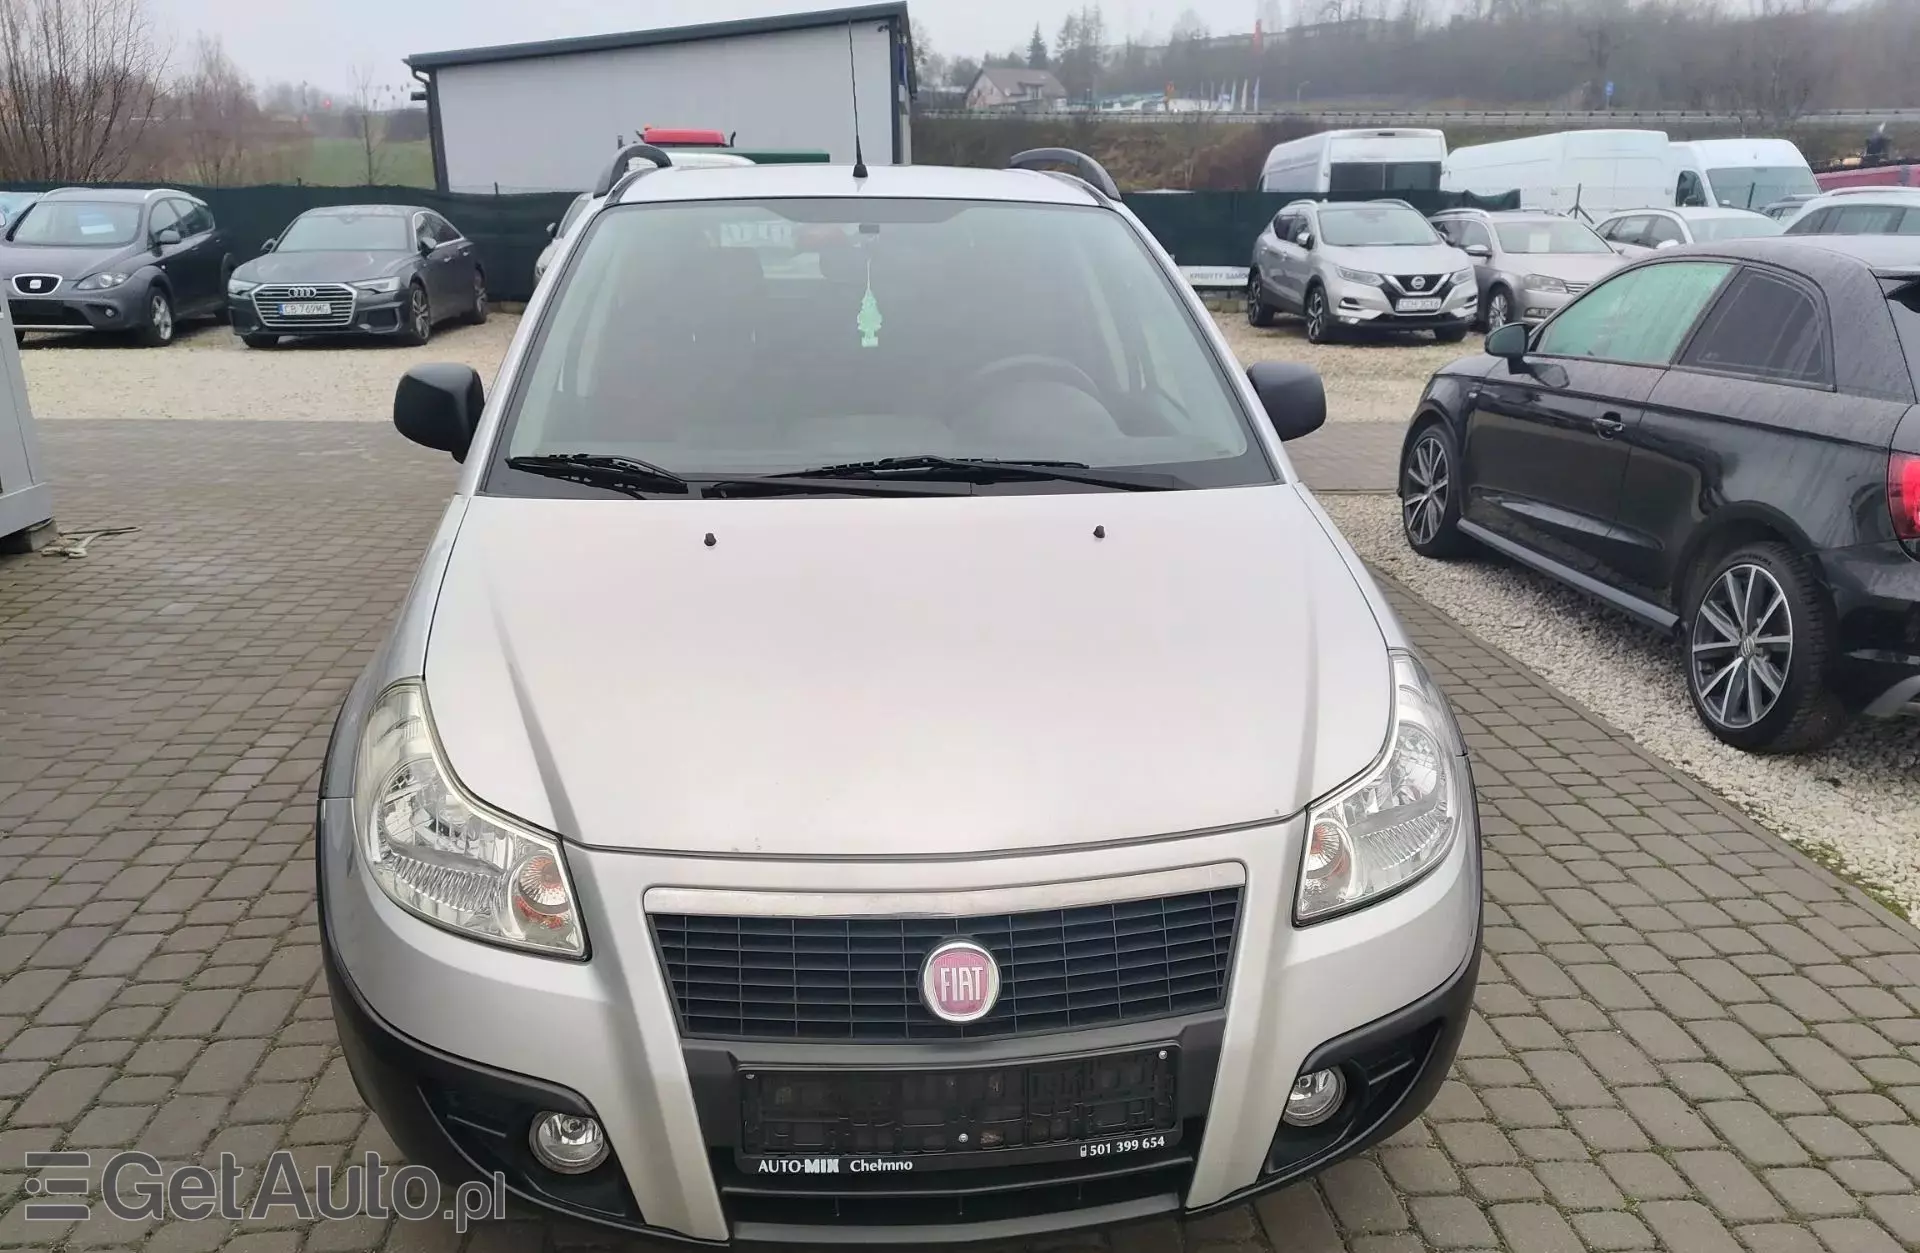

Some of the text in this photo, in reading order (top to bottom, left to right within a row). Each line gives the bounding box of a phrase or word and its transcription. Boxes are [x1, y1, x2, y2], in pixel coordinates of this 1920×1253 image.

[941, 966, 984, 1002] FIAT
[1090, 1136, 1165, 1156] 501 399 654
[758, 1158, 914, 1174] AUTO-MIX Chełmno
